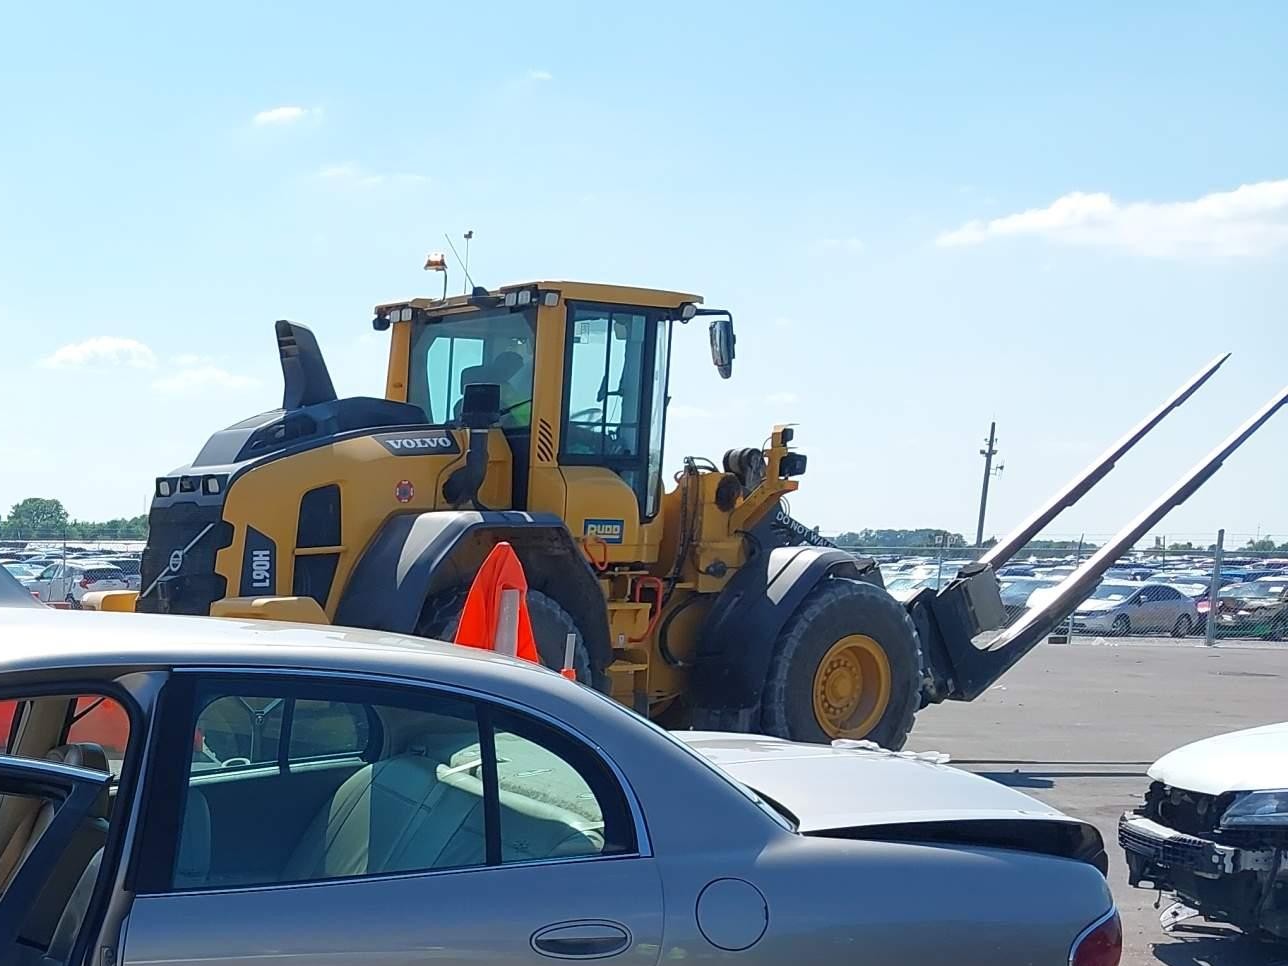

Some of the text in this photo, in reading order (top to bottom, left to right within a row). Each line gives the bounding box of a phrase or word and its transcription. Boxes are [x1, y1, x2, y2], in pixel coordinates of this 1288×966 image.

[385, 437, 452, 449] VOLVO
[776, 511, 791, 525] DO
[790, 520, 810, 537] NOT
[252, 550, 270, 587] L90H
